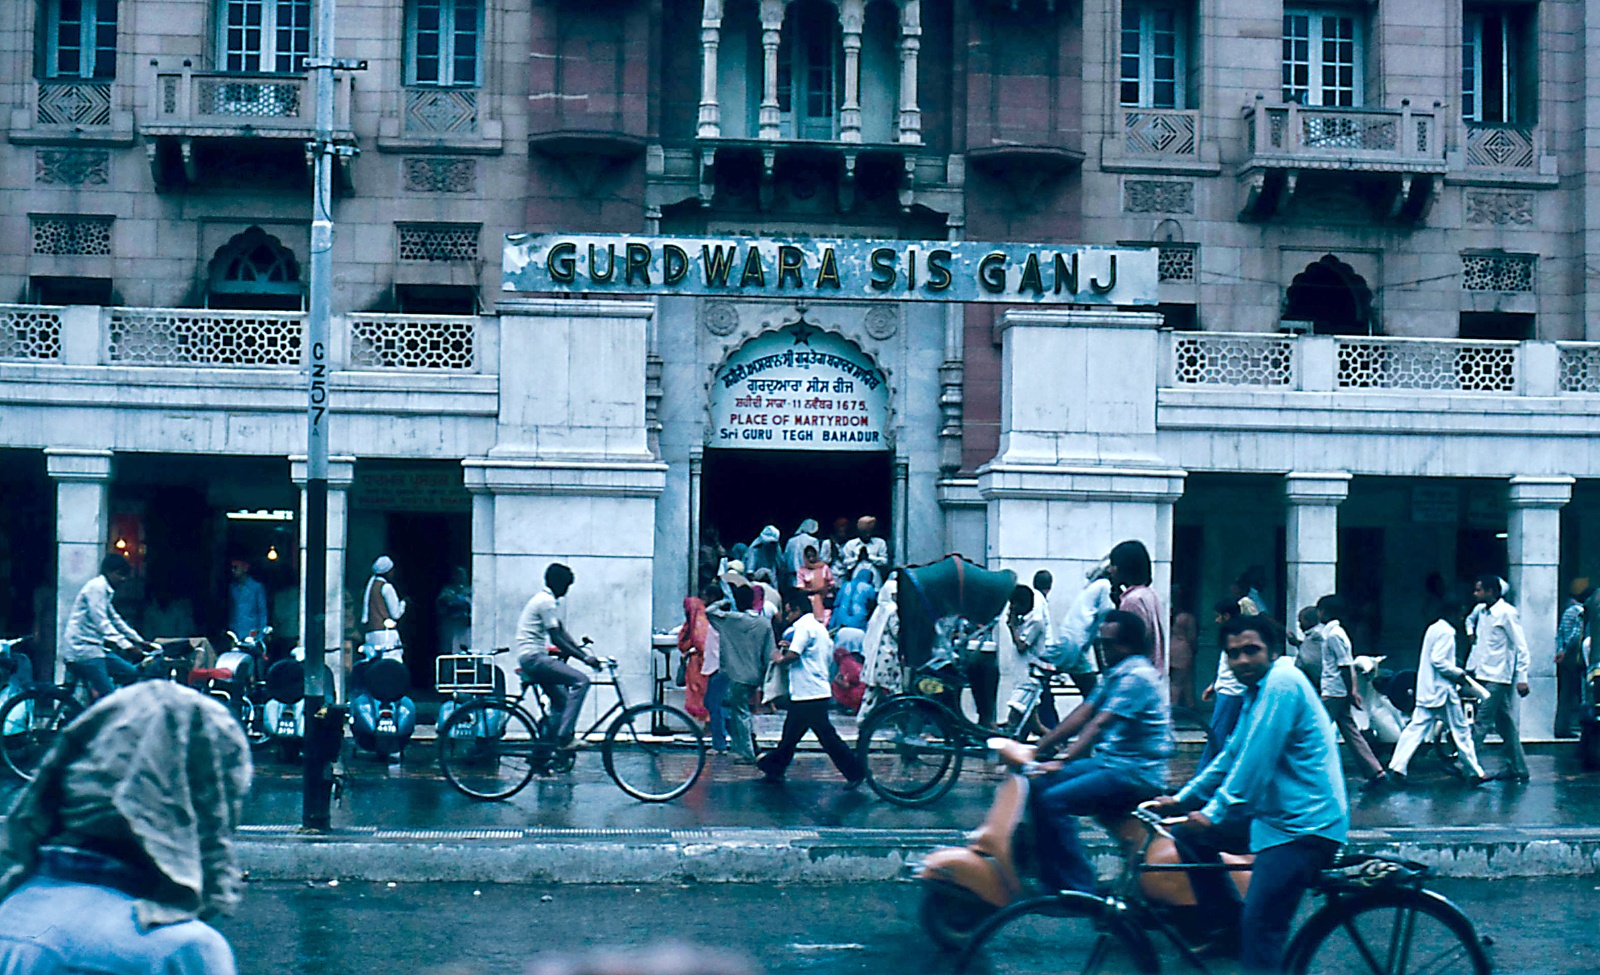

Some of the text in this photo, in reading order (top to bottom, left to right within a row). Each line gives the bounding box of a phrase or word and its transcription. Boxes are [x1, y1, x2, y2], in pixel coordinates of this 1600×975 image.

[547, 242, 1117, 295] GURDWARA SIS GANJ
[730, 413, 869, 427] PLACE OF MARTYRDOM
[742, 429, 773, 440] GURU
[782, 430, 813, 441] TEGH
[822, 431, 880, 442] BAHADUR
